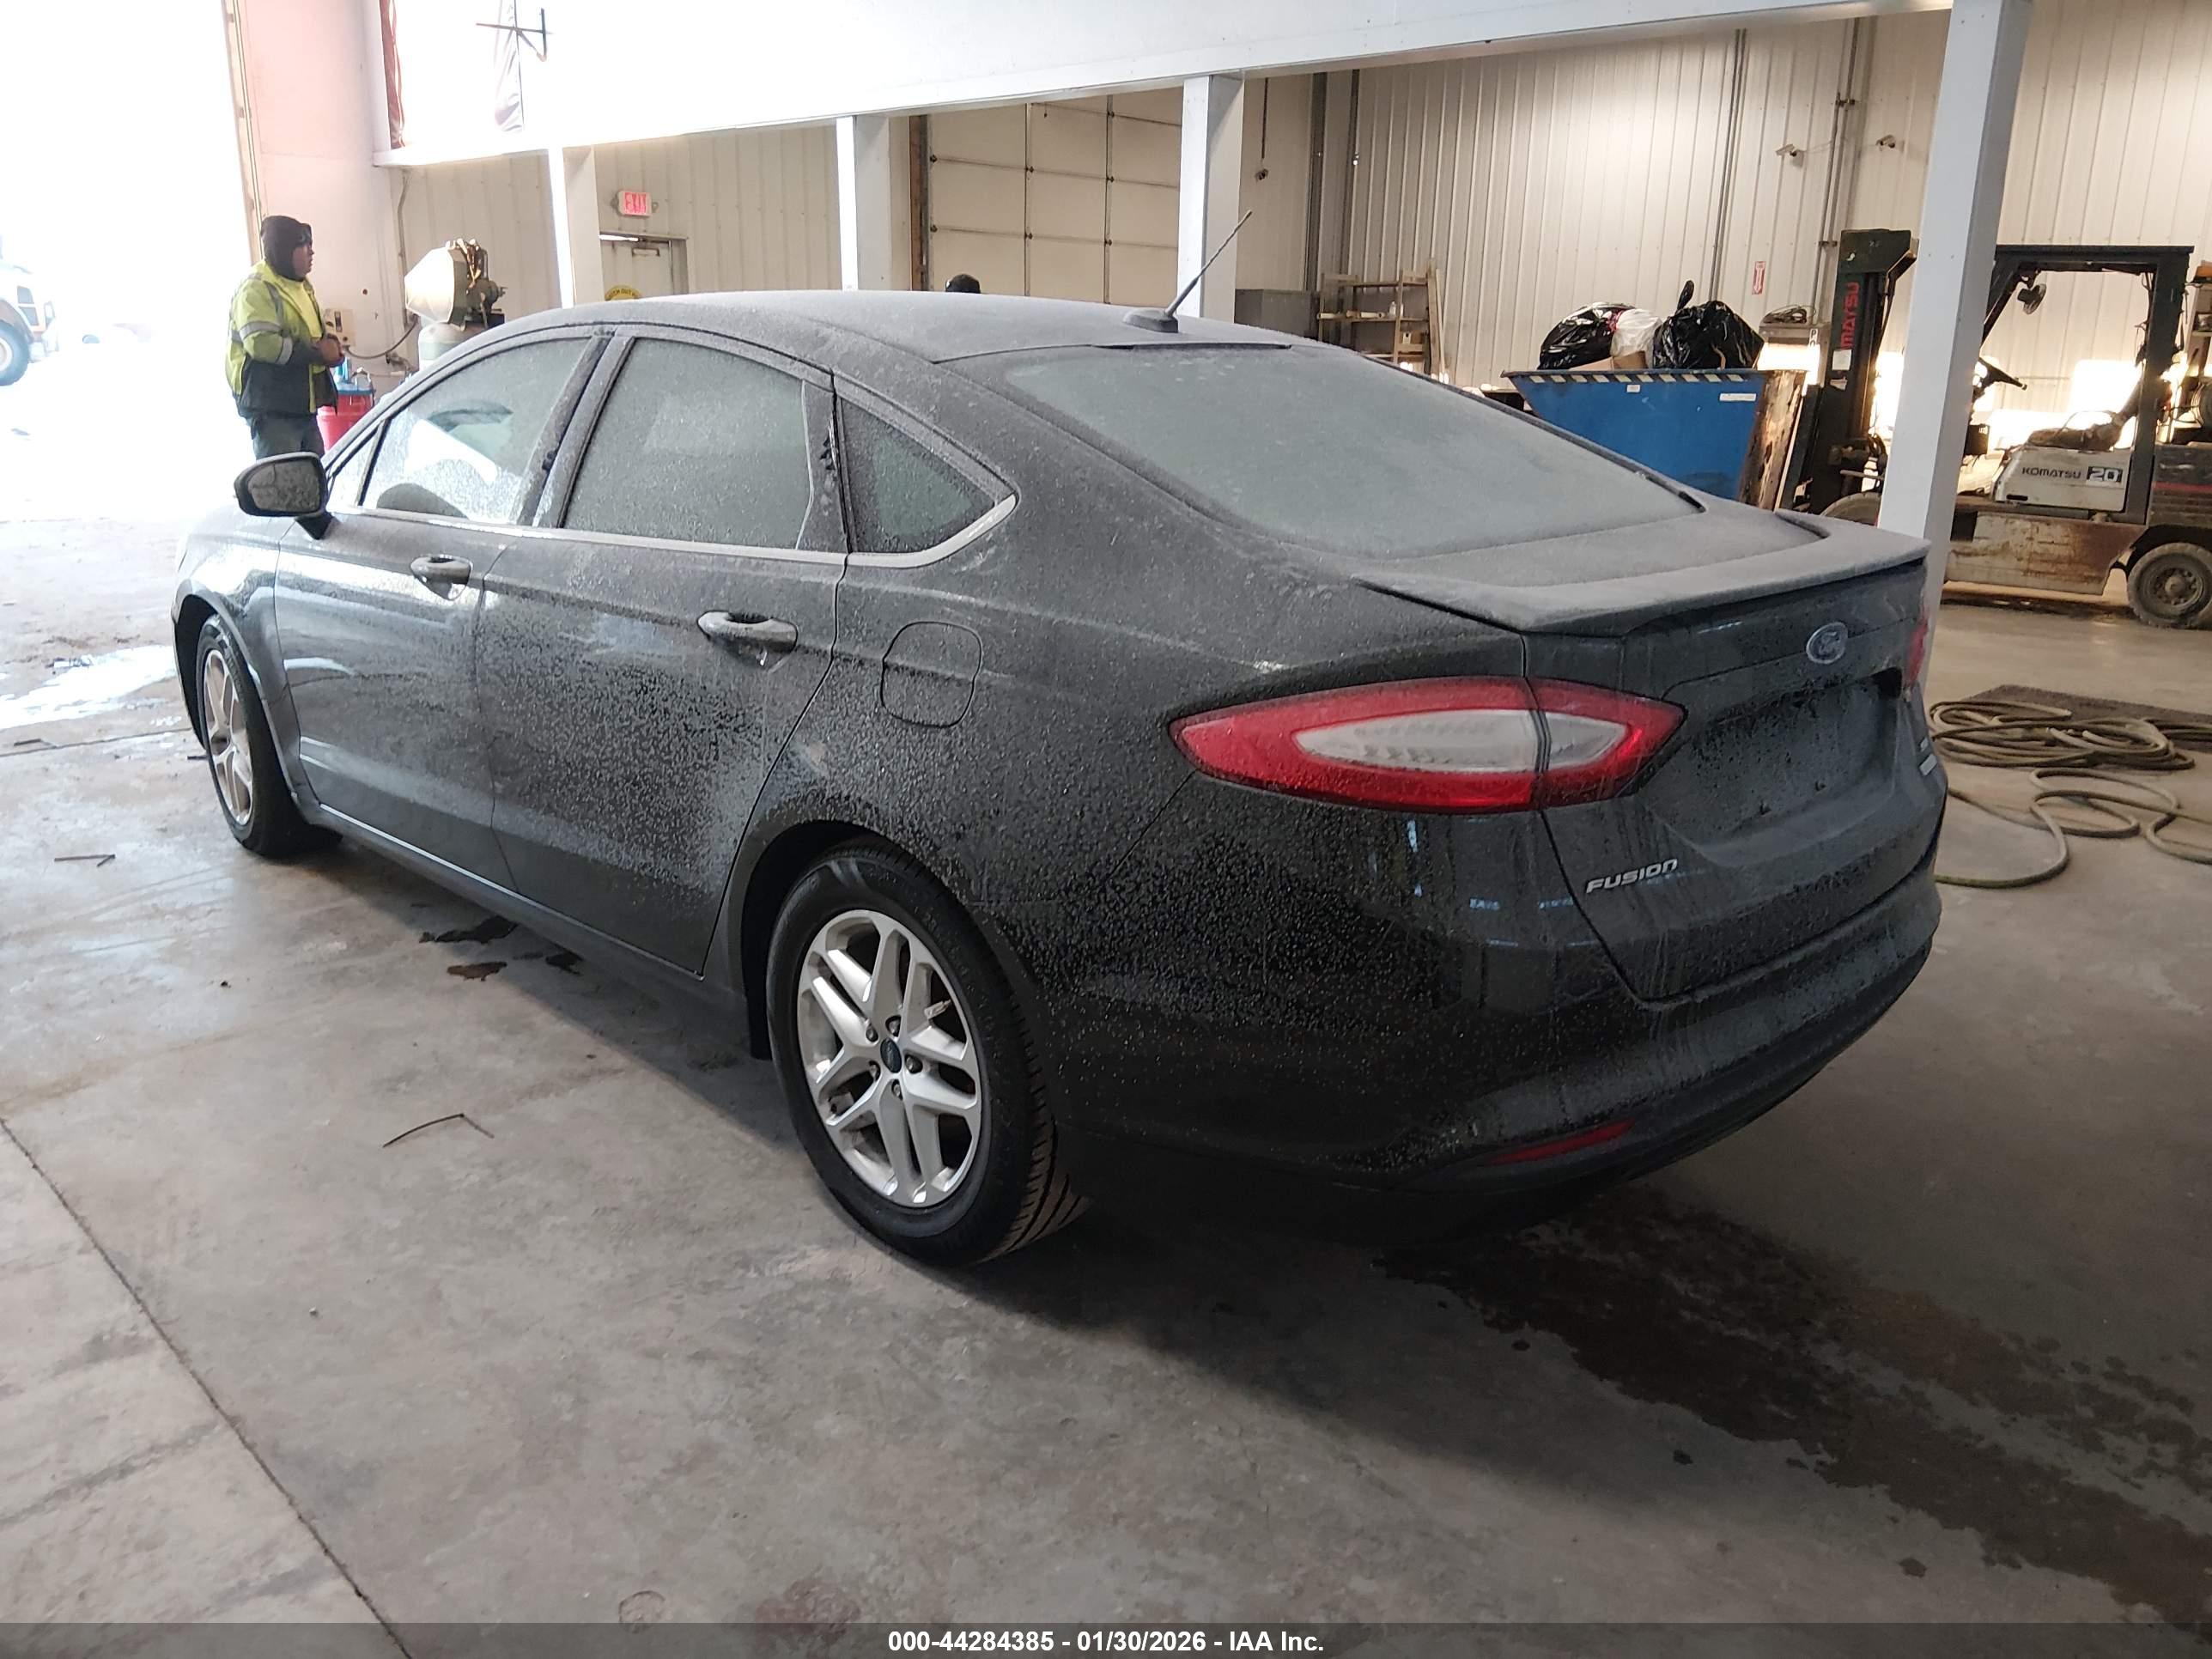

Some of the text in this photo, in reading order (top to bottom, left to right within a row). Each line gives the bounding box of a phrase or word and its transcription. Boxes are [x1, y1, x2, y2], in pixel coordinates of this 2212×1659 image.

[1840, 280, 1861, 349] MATSU
[2021, 466, 2120, 482] KOMATSU 20
[1586, 859, 1678, 893] FUSION
